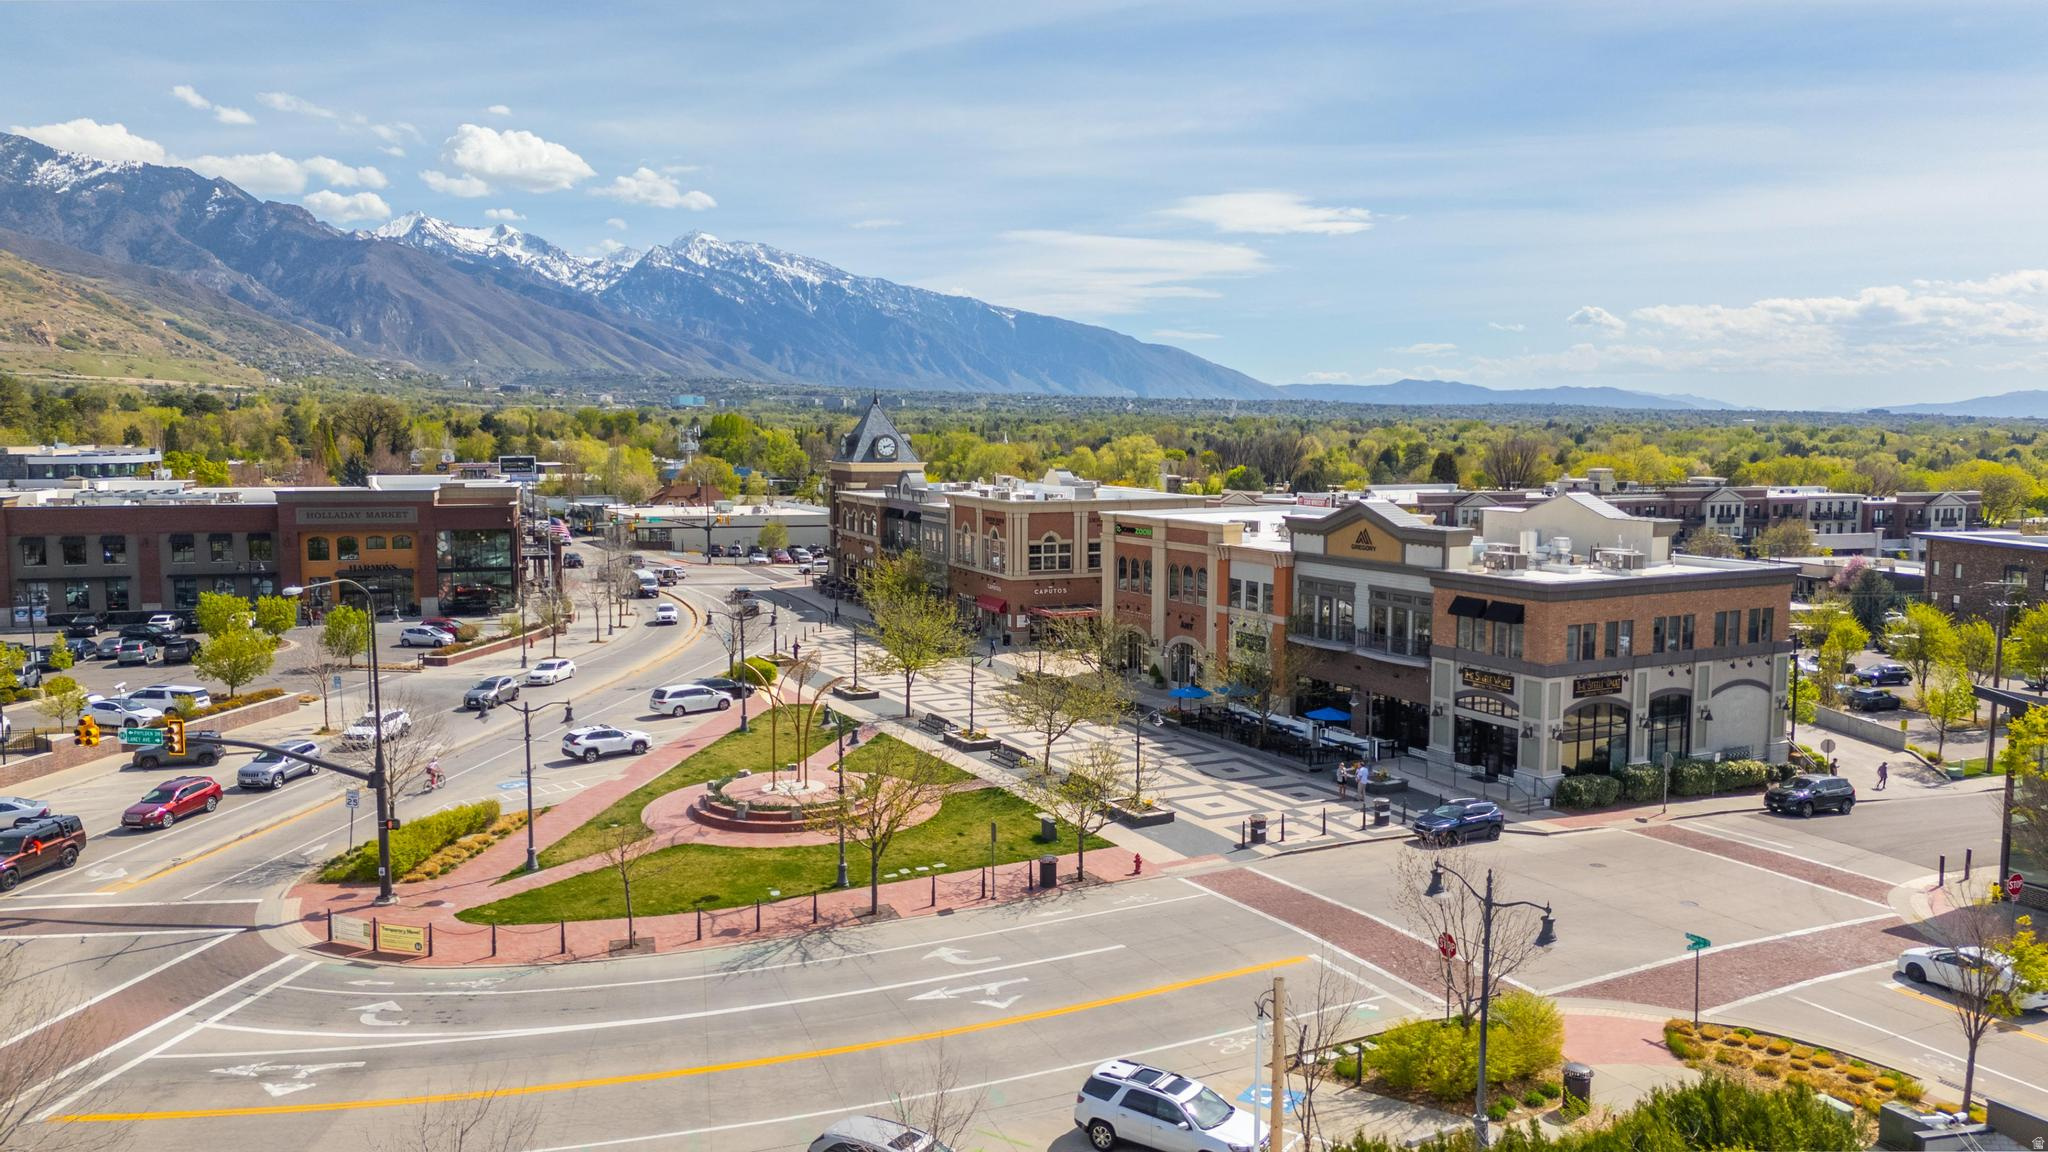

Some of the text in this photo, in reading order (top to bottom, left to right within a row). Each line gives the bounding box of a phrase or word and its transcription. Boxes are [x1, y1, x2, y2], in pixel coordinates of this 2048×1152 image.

[306, 511, 409, 520] HOLLADAY MARKET
[1351, 543, 1376, 552] GREGORY
[1034, 587, 1068, 595] CAPUTOS
[347, 798, 358, 806] 25
[2009, 880, 2023, 890] STOP
[1439, 936, 1456, 952] STOP
